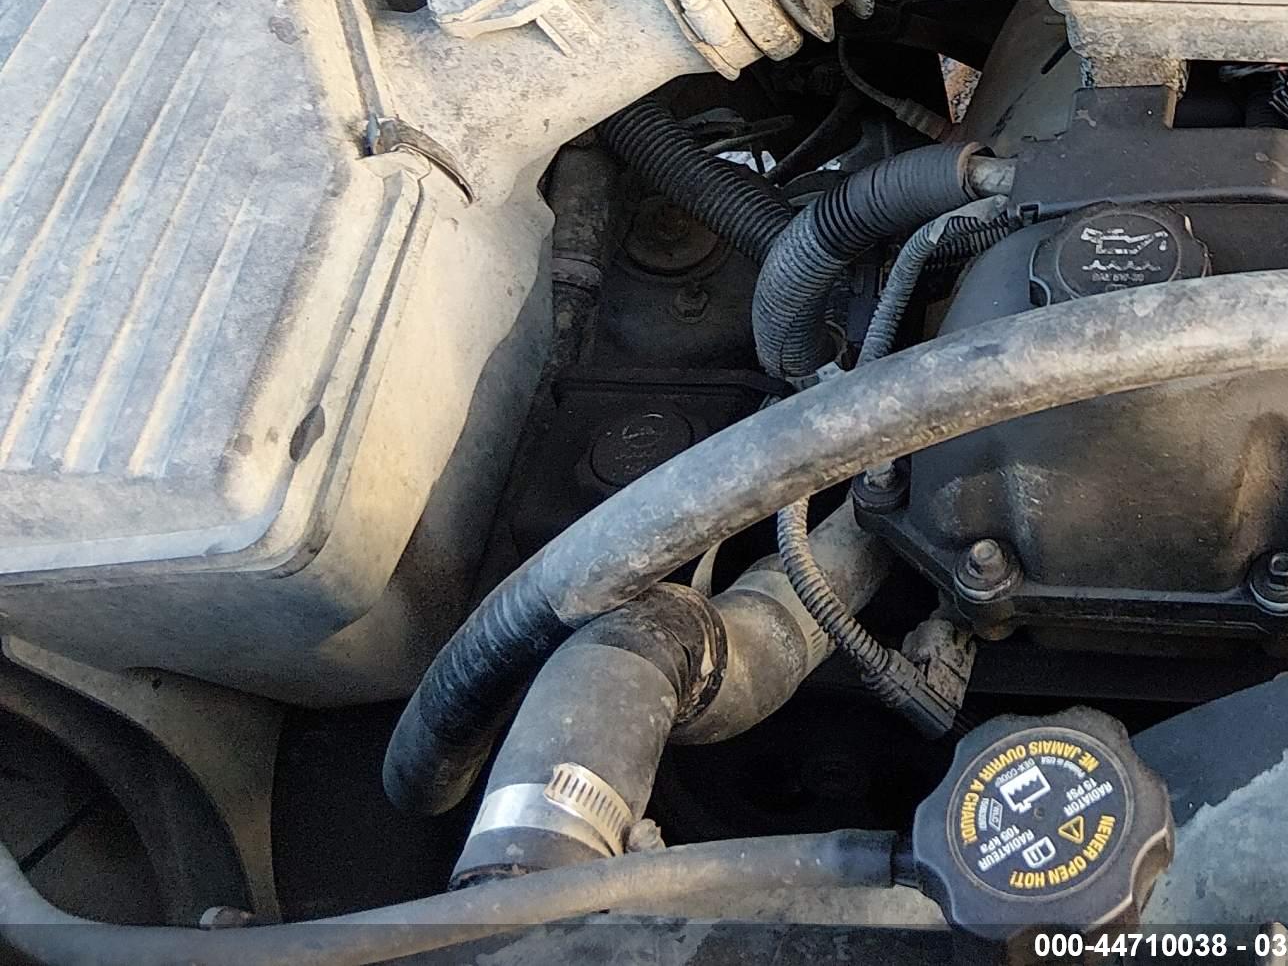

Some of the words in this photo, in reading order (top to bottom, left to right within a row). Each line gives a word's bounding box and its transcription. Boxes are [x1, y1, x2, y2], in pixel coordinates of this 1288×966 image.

[978, 744, 1026, 780] OUVRIR
[1029, 740, 1082, 759] JAMAIS
[1063, 781, 1114, 817] RADIATOR
[1082, 777, 1098, 792] 15
[960, 791, 979, 846] CHAUD!
[978, 829, 1035, 872] RADIATEUR
[1083, 814, 1116, 861] NEVER
[1009, 870, 1046, 889] HOT!
[1049, 858, 1088, 885] OPEN
